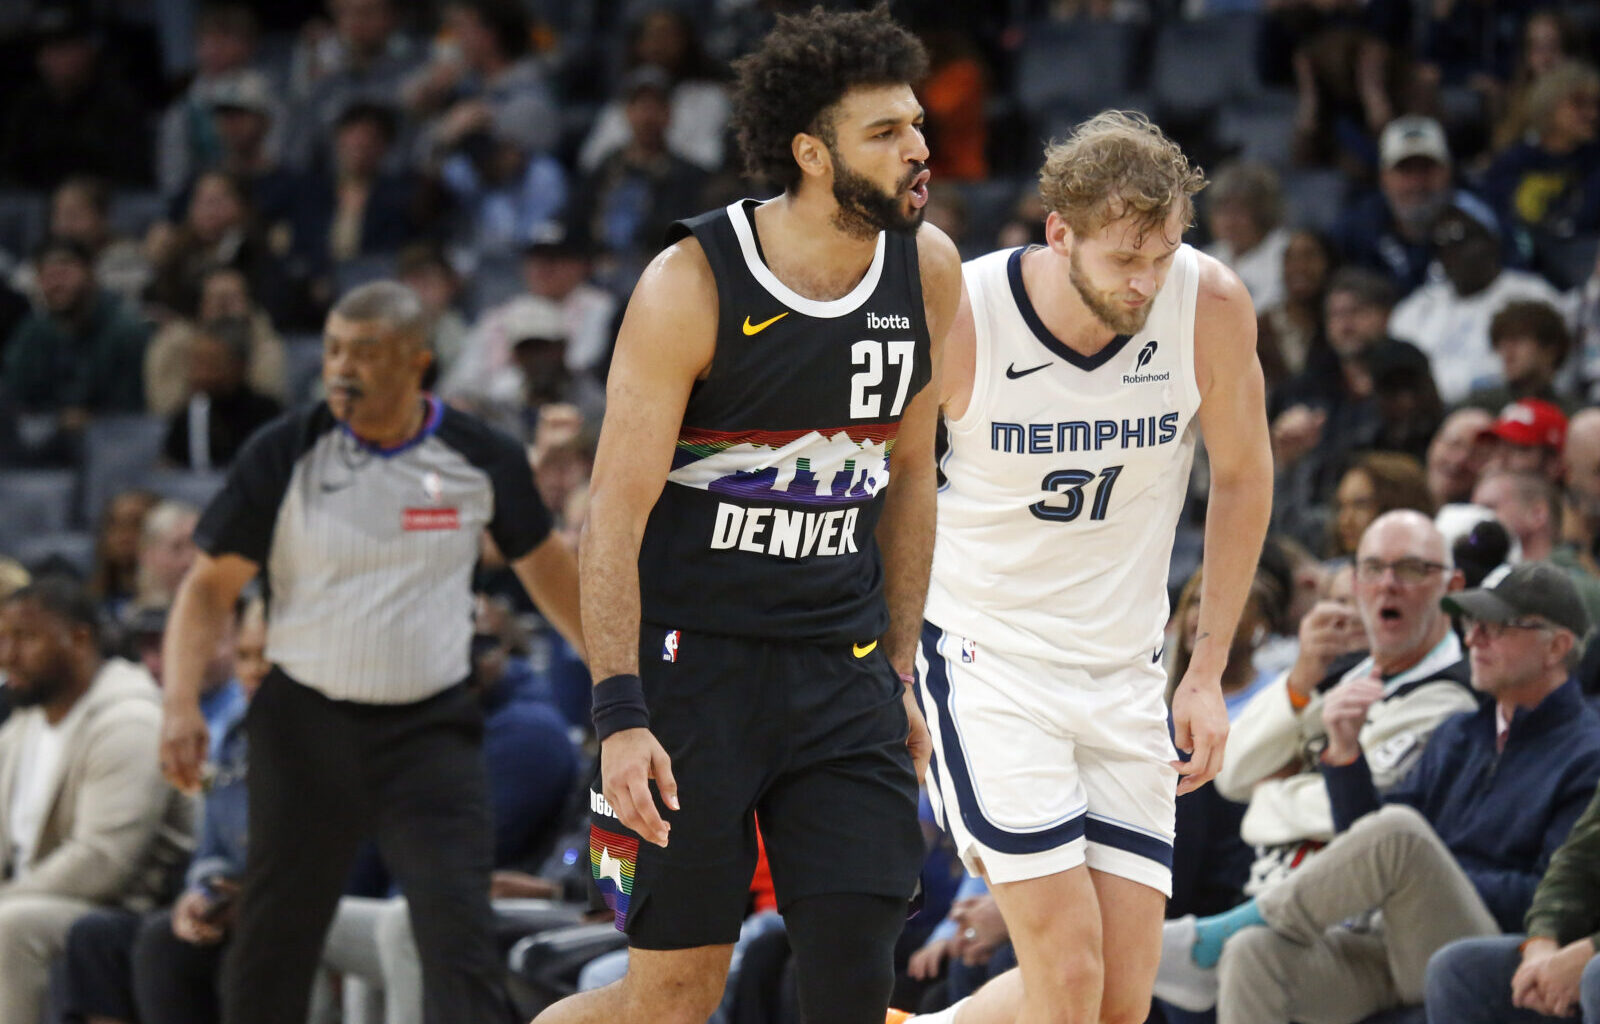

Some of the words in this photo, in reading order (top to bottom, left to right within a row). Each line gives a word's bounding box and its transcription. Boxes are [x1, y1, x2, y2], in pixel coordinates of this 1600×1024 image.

[866, 312, 910, 329] ibotta
[849, 340, 916, 419] 27
[1122, 371, 1170, 384] Robinhood
[991, 412, 1179, 454] MEMPHIS
[1028, 465, 1124, 522] 31
[710, 502, 859, 559] DENVER
